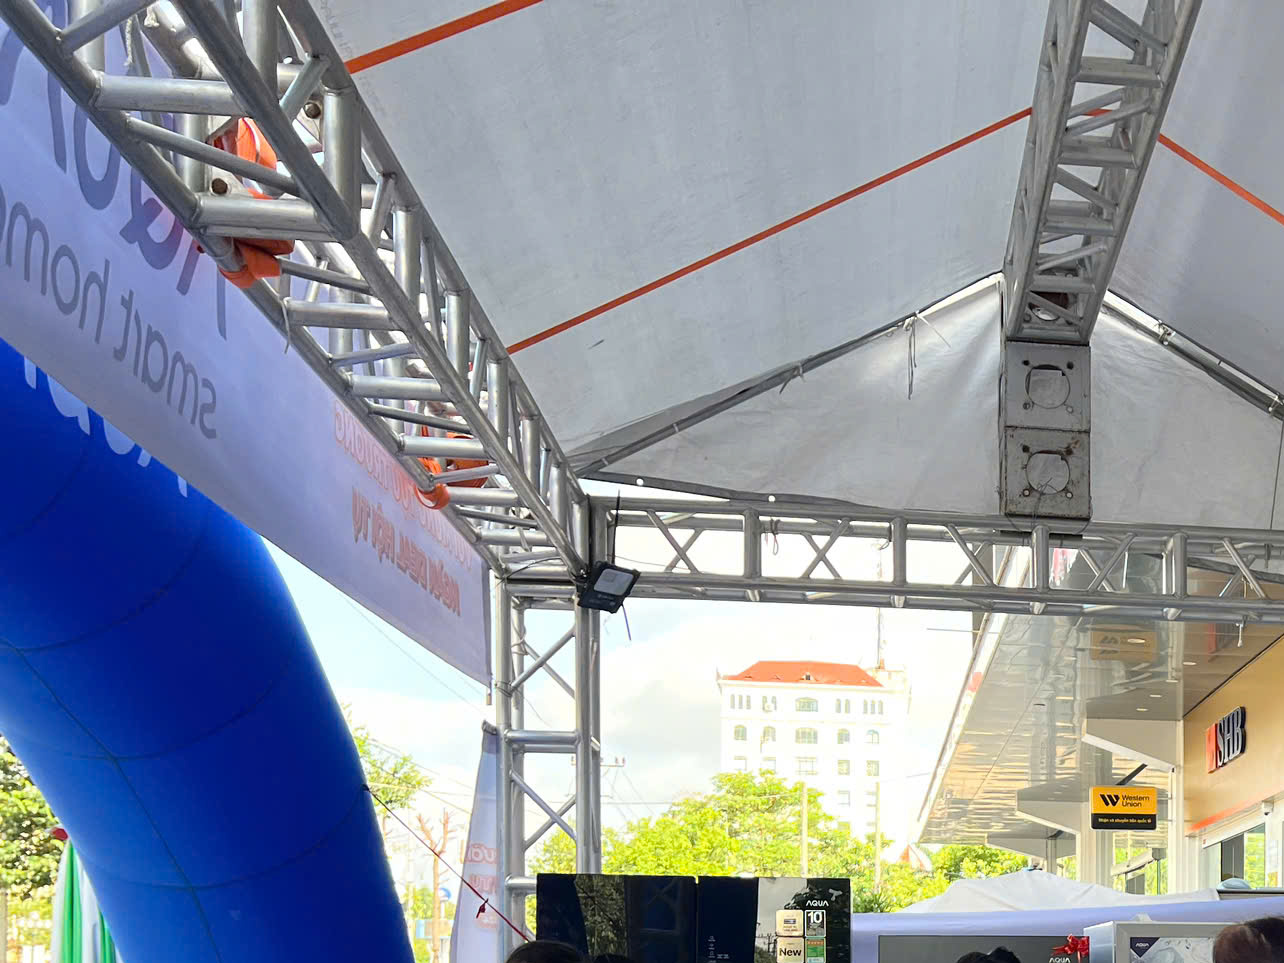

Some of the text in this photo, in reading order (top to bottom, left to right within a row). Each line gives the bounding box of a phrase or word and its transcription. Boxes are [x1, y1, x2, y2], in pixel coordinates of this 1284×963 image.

[1217, 706, 1246, 767] SHB
[807, 911, 823, 924] 10
[780, 948, 802, 956] New
